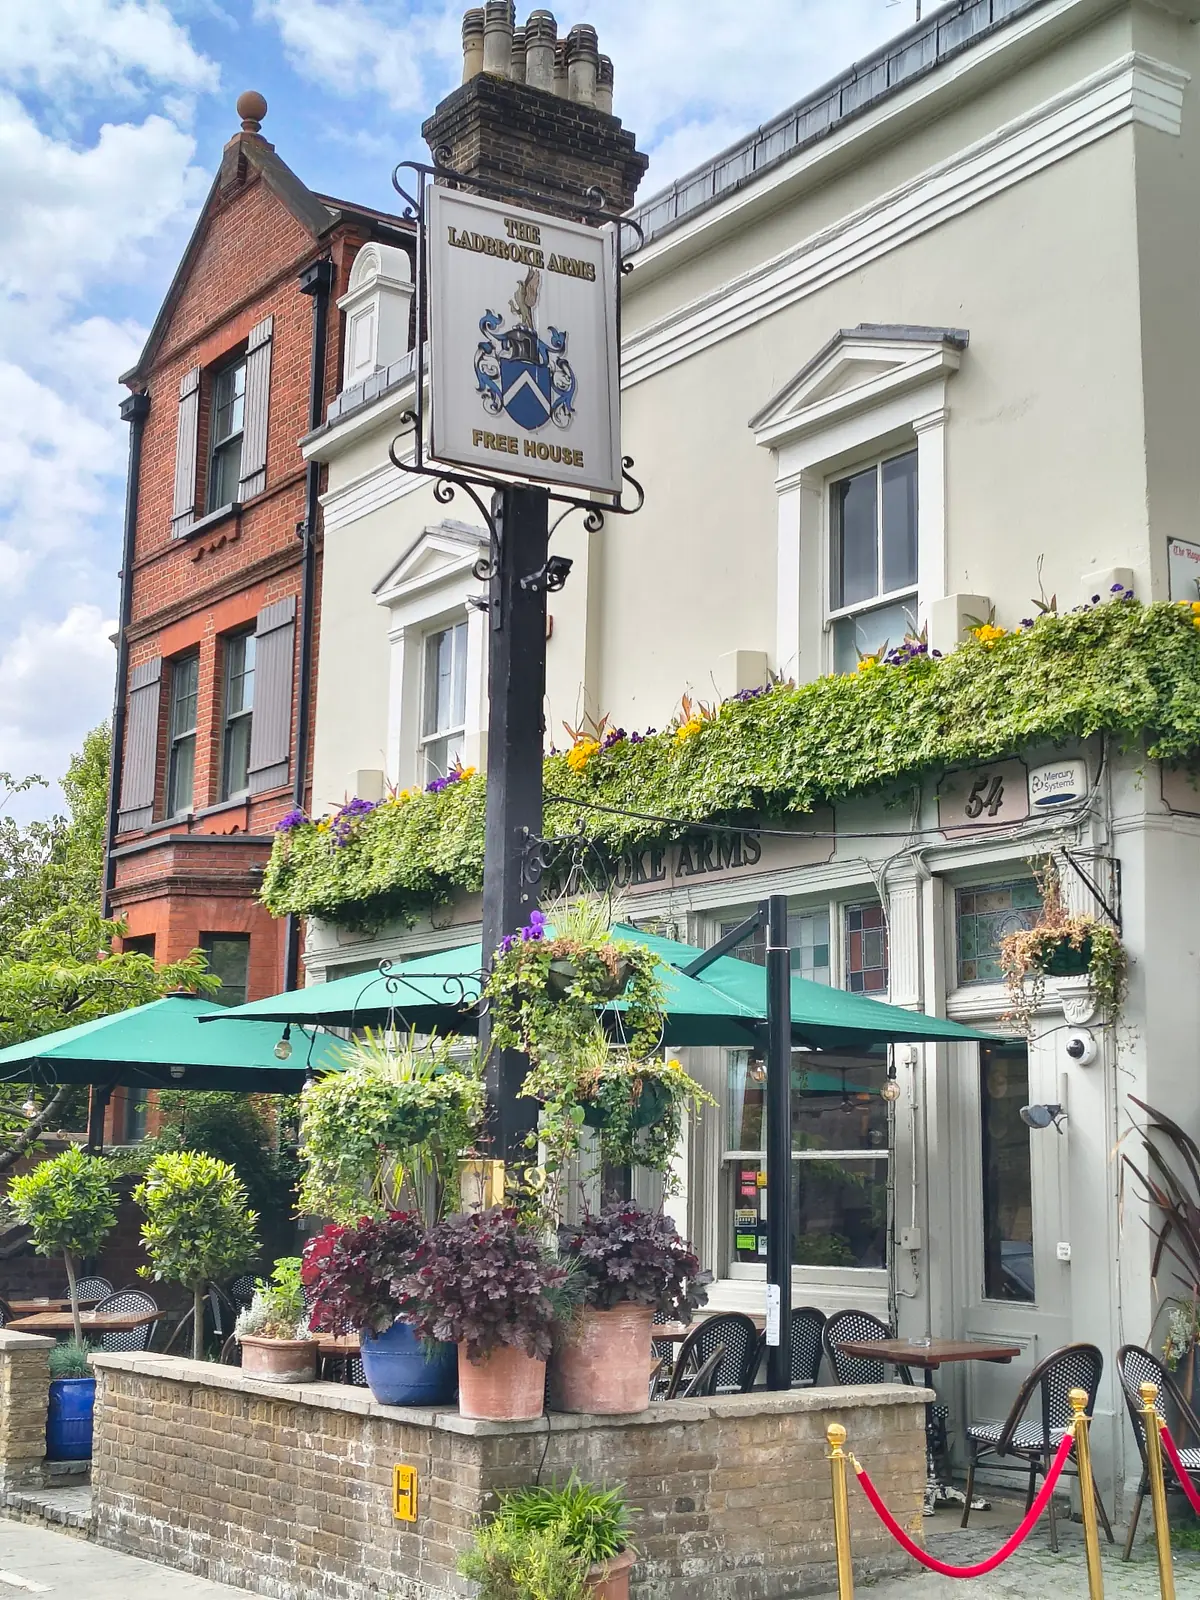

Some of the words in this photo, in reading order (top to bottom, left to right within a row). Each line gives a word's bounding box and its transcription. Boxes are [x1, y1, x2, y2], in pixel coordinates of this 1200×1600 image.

[504, 217, 541, 245] THE
[448, 226, 544, 268] LADBROKE
[547, 256, 596, 282] ARMS
[472, 428, 518, 455] FREE
[523, 439, 584, 468] HOUSE
[1044, 769, 1075, 782] Mercury
[1044, 779, 1075, 793] Systems
[965, 774, 1005, 818] 54
[675, 824, 762, 878] ARMS
